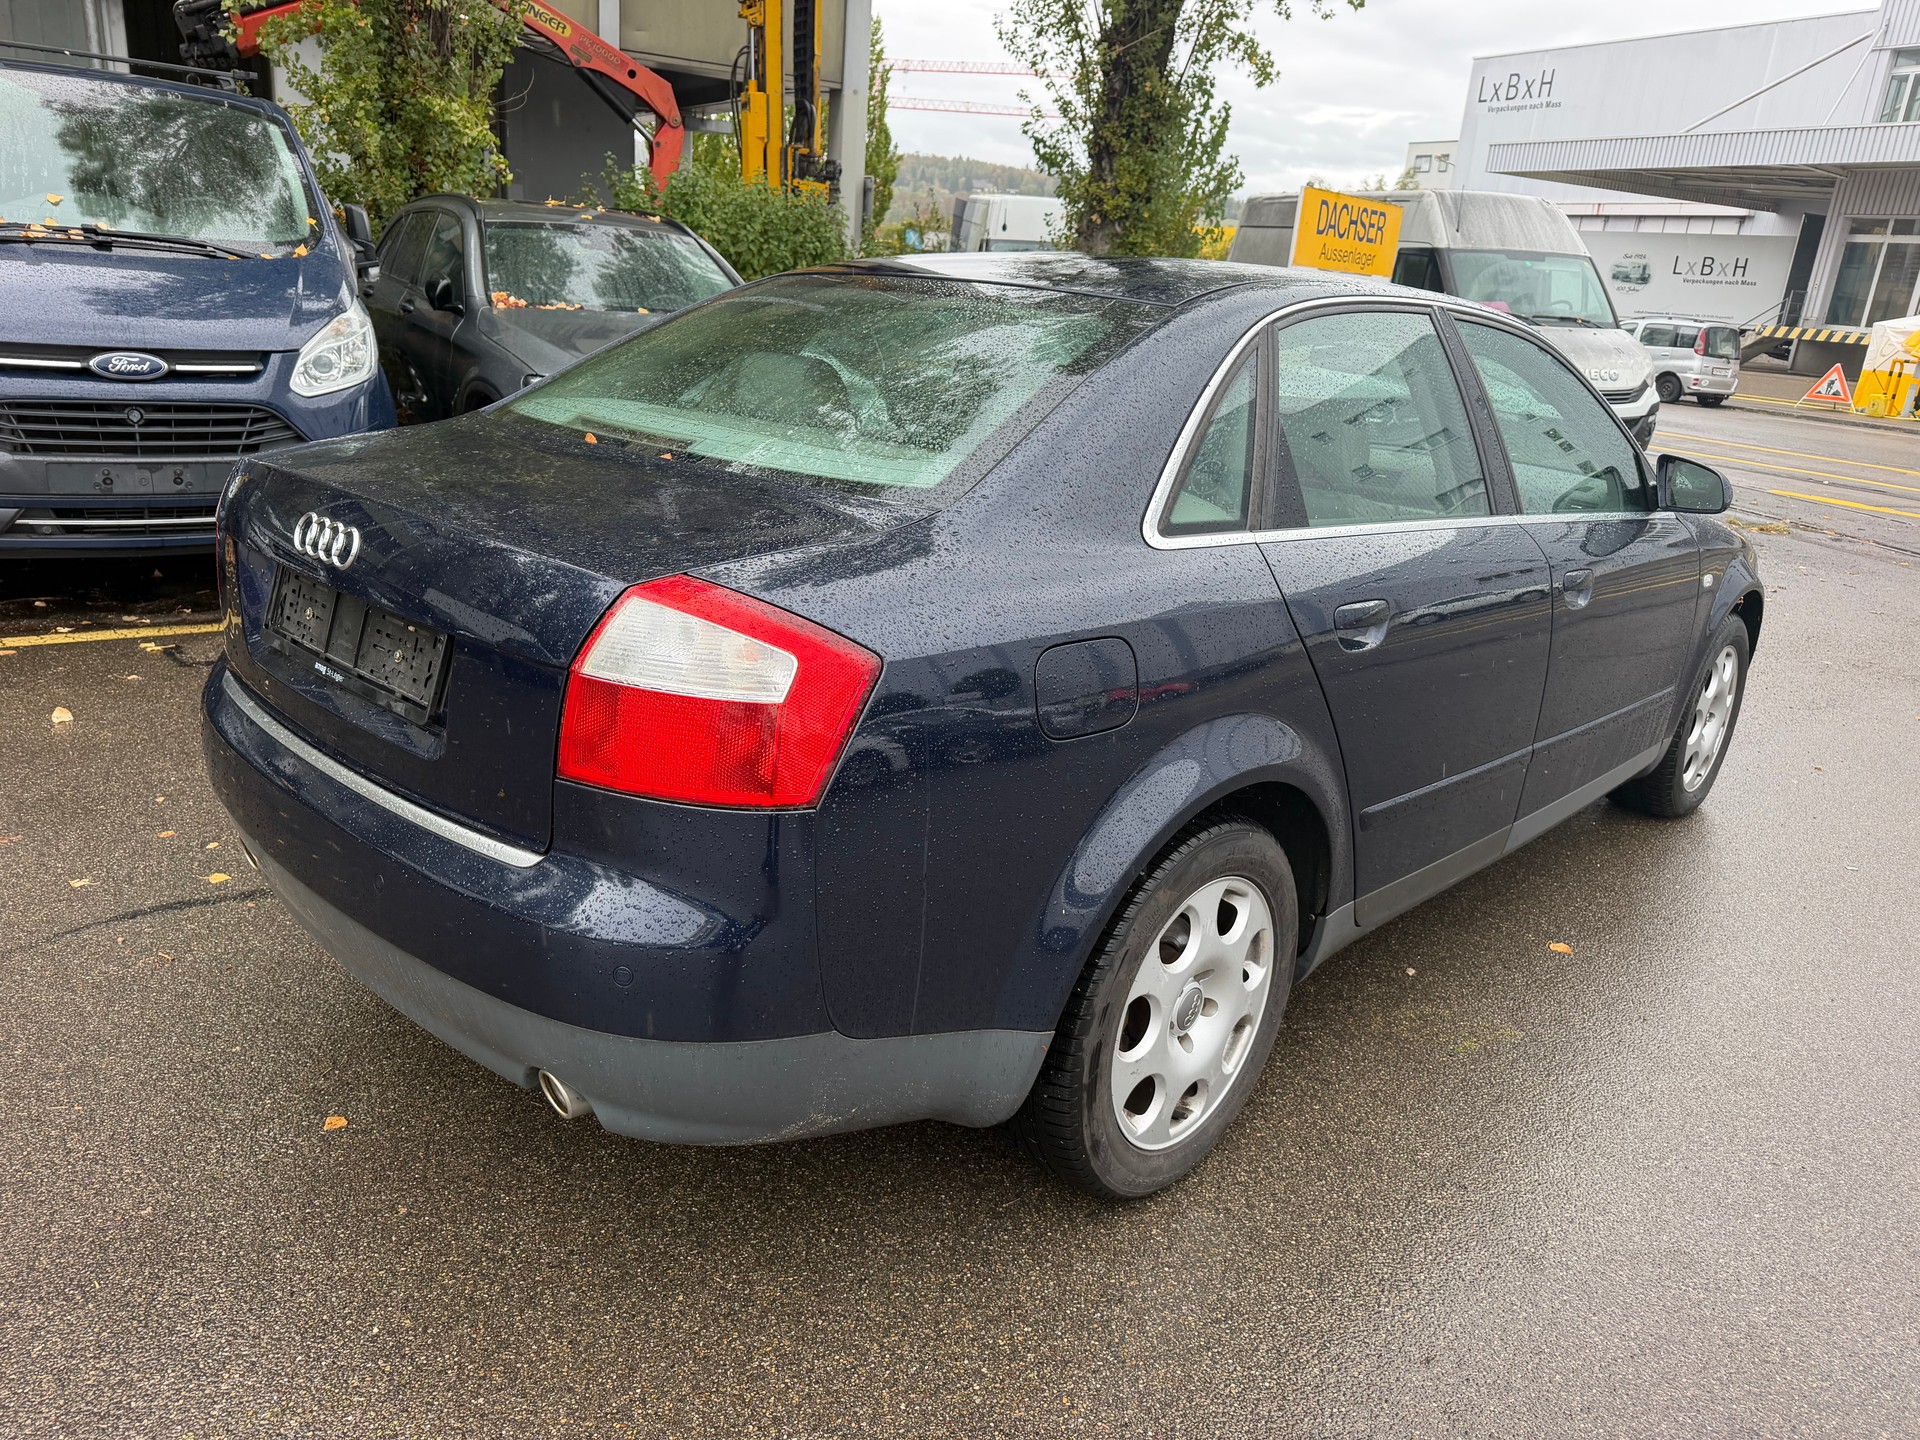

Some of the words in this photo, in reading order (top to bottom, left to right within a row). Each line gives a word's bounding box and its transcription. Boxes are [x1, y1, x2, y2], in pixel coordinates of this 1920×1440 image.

[1478, 68, 1556, 103] LxBxH
[1487, 104, 1528, 114] Verpackungen
[1529, 101, 1544, 109] nach
[1545, 100, 1562, 109] Mass
[1316, 199, 1387, 245] DACHSER
[1319, 243, 1376, 270] Aussenlager
[1672, 255, 1749, 278] LxBxH
[1682, 277, 1724, 286] Verpackungen
[108, 356, 151, 373] Ford
